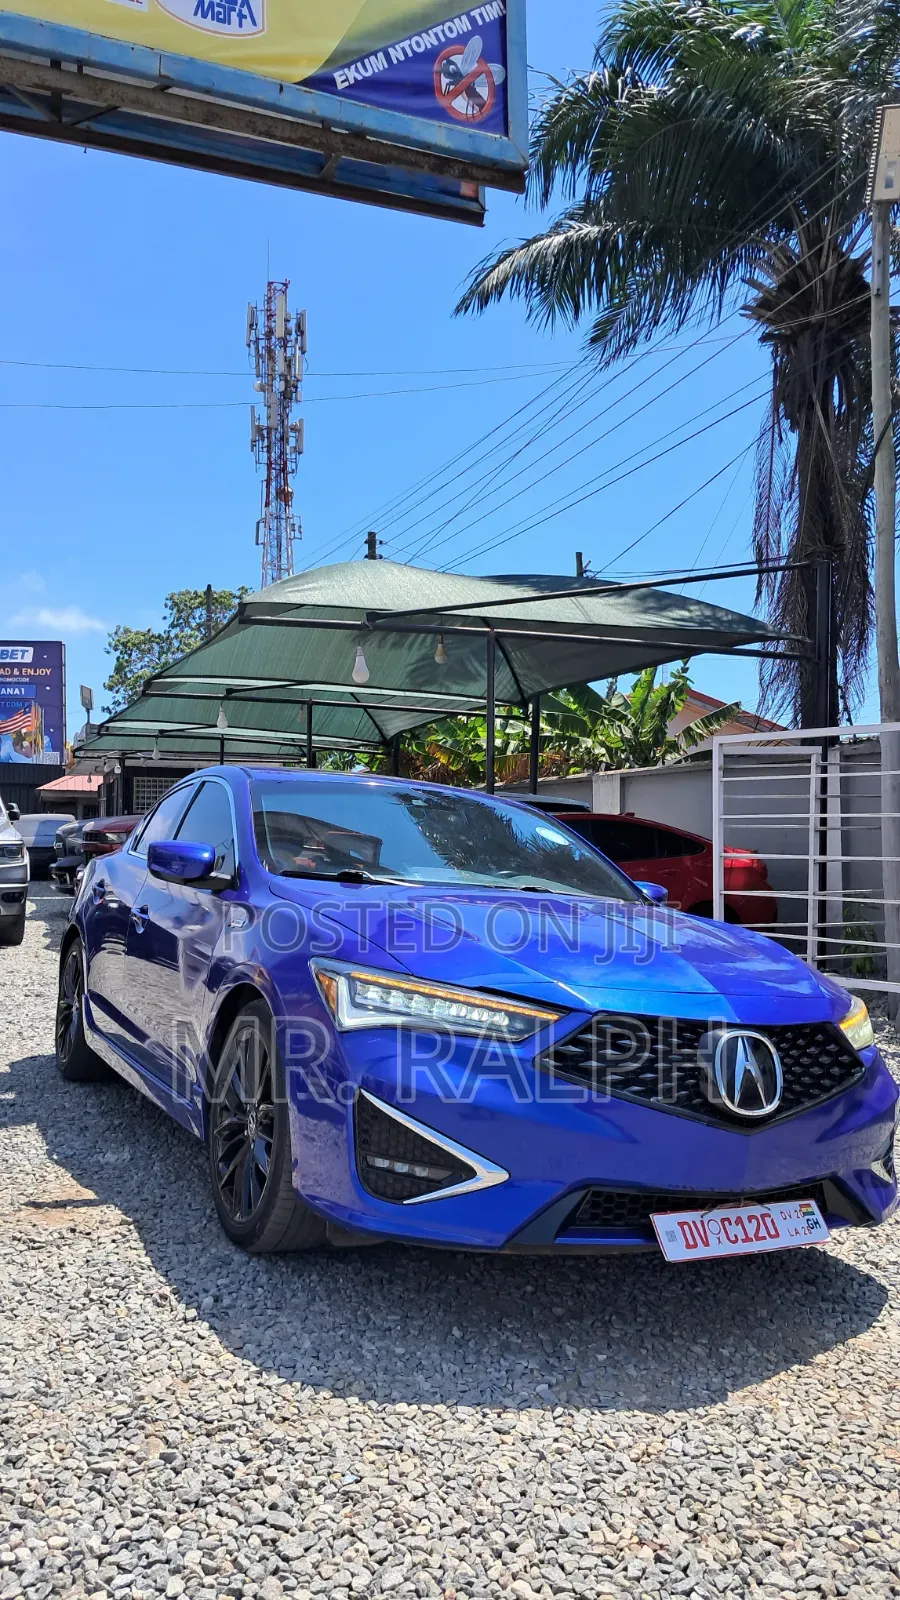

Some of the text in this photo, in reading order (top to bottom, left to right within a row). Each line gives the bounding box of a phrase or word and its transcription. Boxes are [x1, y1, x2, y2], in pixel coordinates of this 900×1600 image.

[333, 52, 388, 90] EKUM
[388, 15, 472, 65] NTONTOM
[0, 649, 29, 660] BET
[22, 668, 52, 676] ENJOY
[0, 687, 25, 695] ANA1
[806, 1217, 821, 1229] GH
[677, 1213, 780, 1249] DV C120
[787, 1227, 801, 1236] LA
